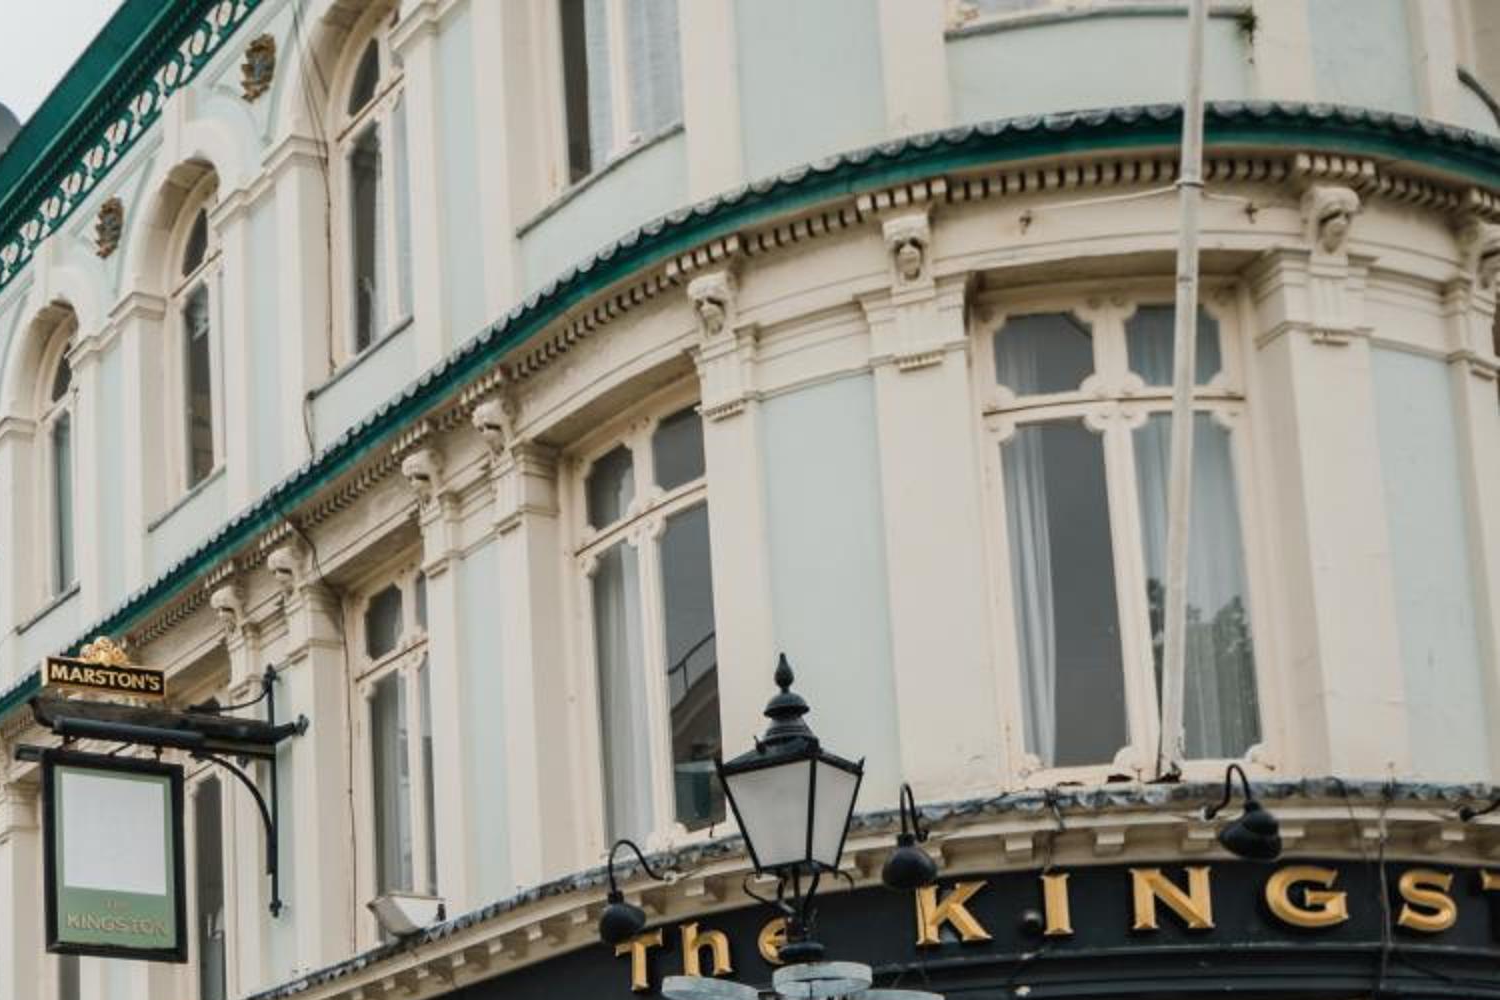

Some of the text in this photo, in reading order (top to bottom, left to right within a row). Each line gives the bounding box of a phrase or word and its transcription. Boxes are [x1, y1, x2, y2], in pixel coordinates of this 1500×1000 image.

[51, 663, 161, 691] MARSTON'S
[915, 864, 1500, 946] KINGS
[66, 911, 165, 936] KINGSTON
